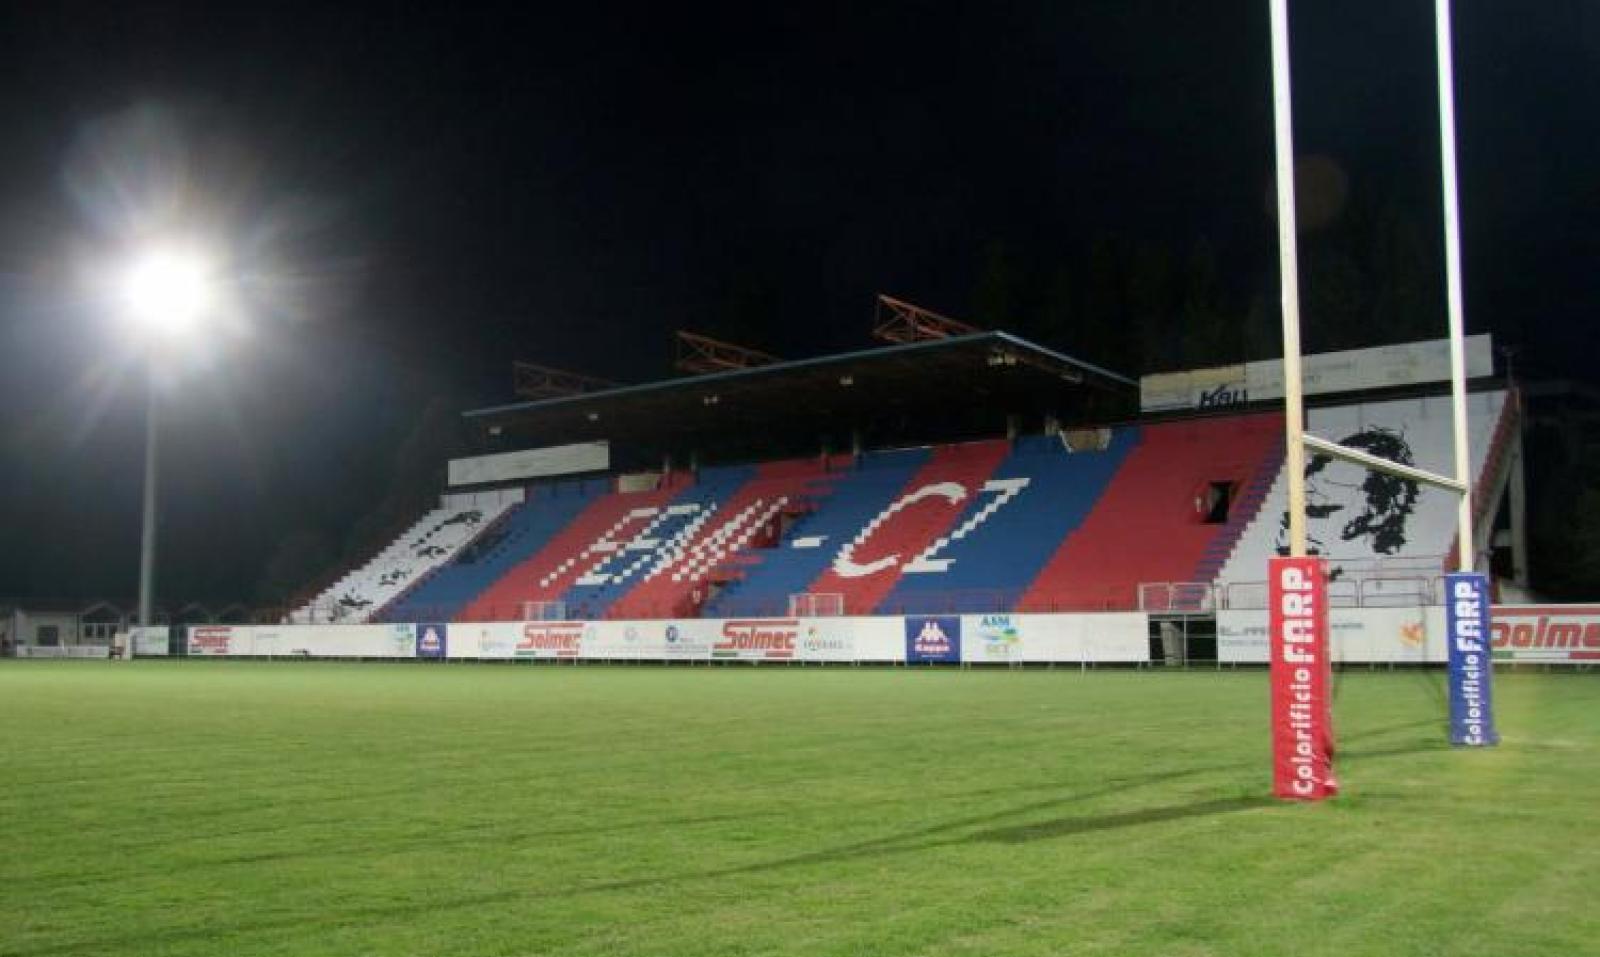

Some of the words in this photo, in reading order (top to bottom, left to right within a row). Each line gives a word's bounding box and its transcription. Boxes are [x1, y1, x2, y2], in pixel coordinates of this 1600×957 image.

[713, 620, 799, 649] Solmec
[1281, 567, 1315, 662] FARP
[1455, 582, 1482, 651] FARP
[1290, 668, 1314, 794] Colorificio
[1460, 654, 1482, 744] Colorificio
